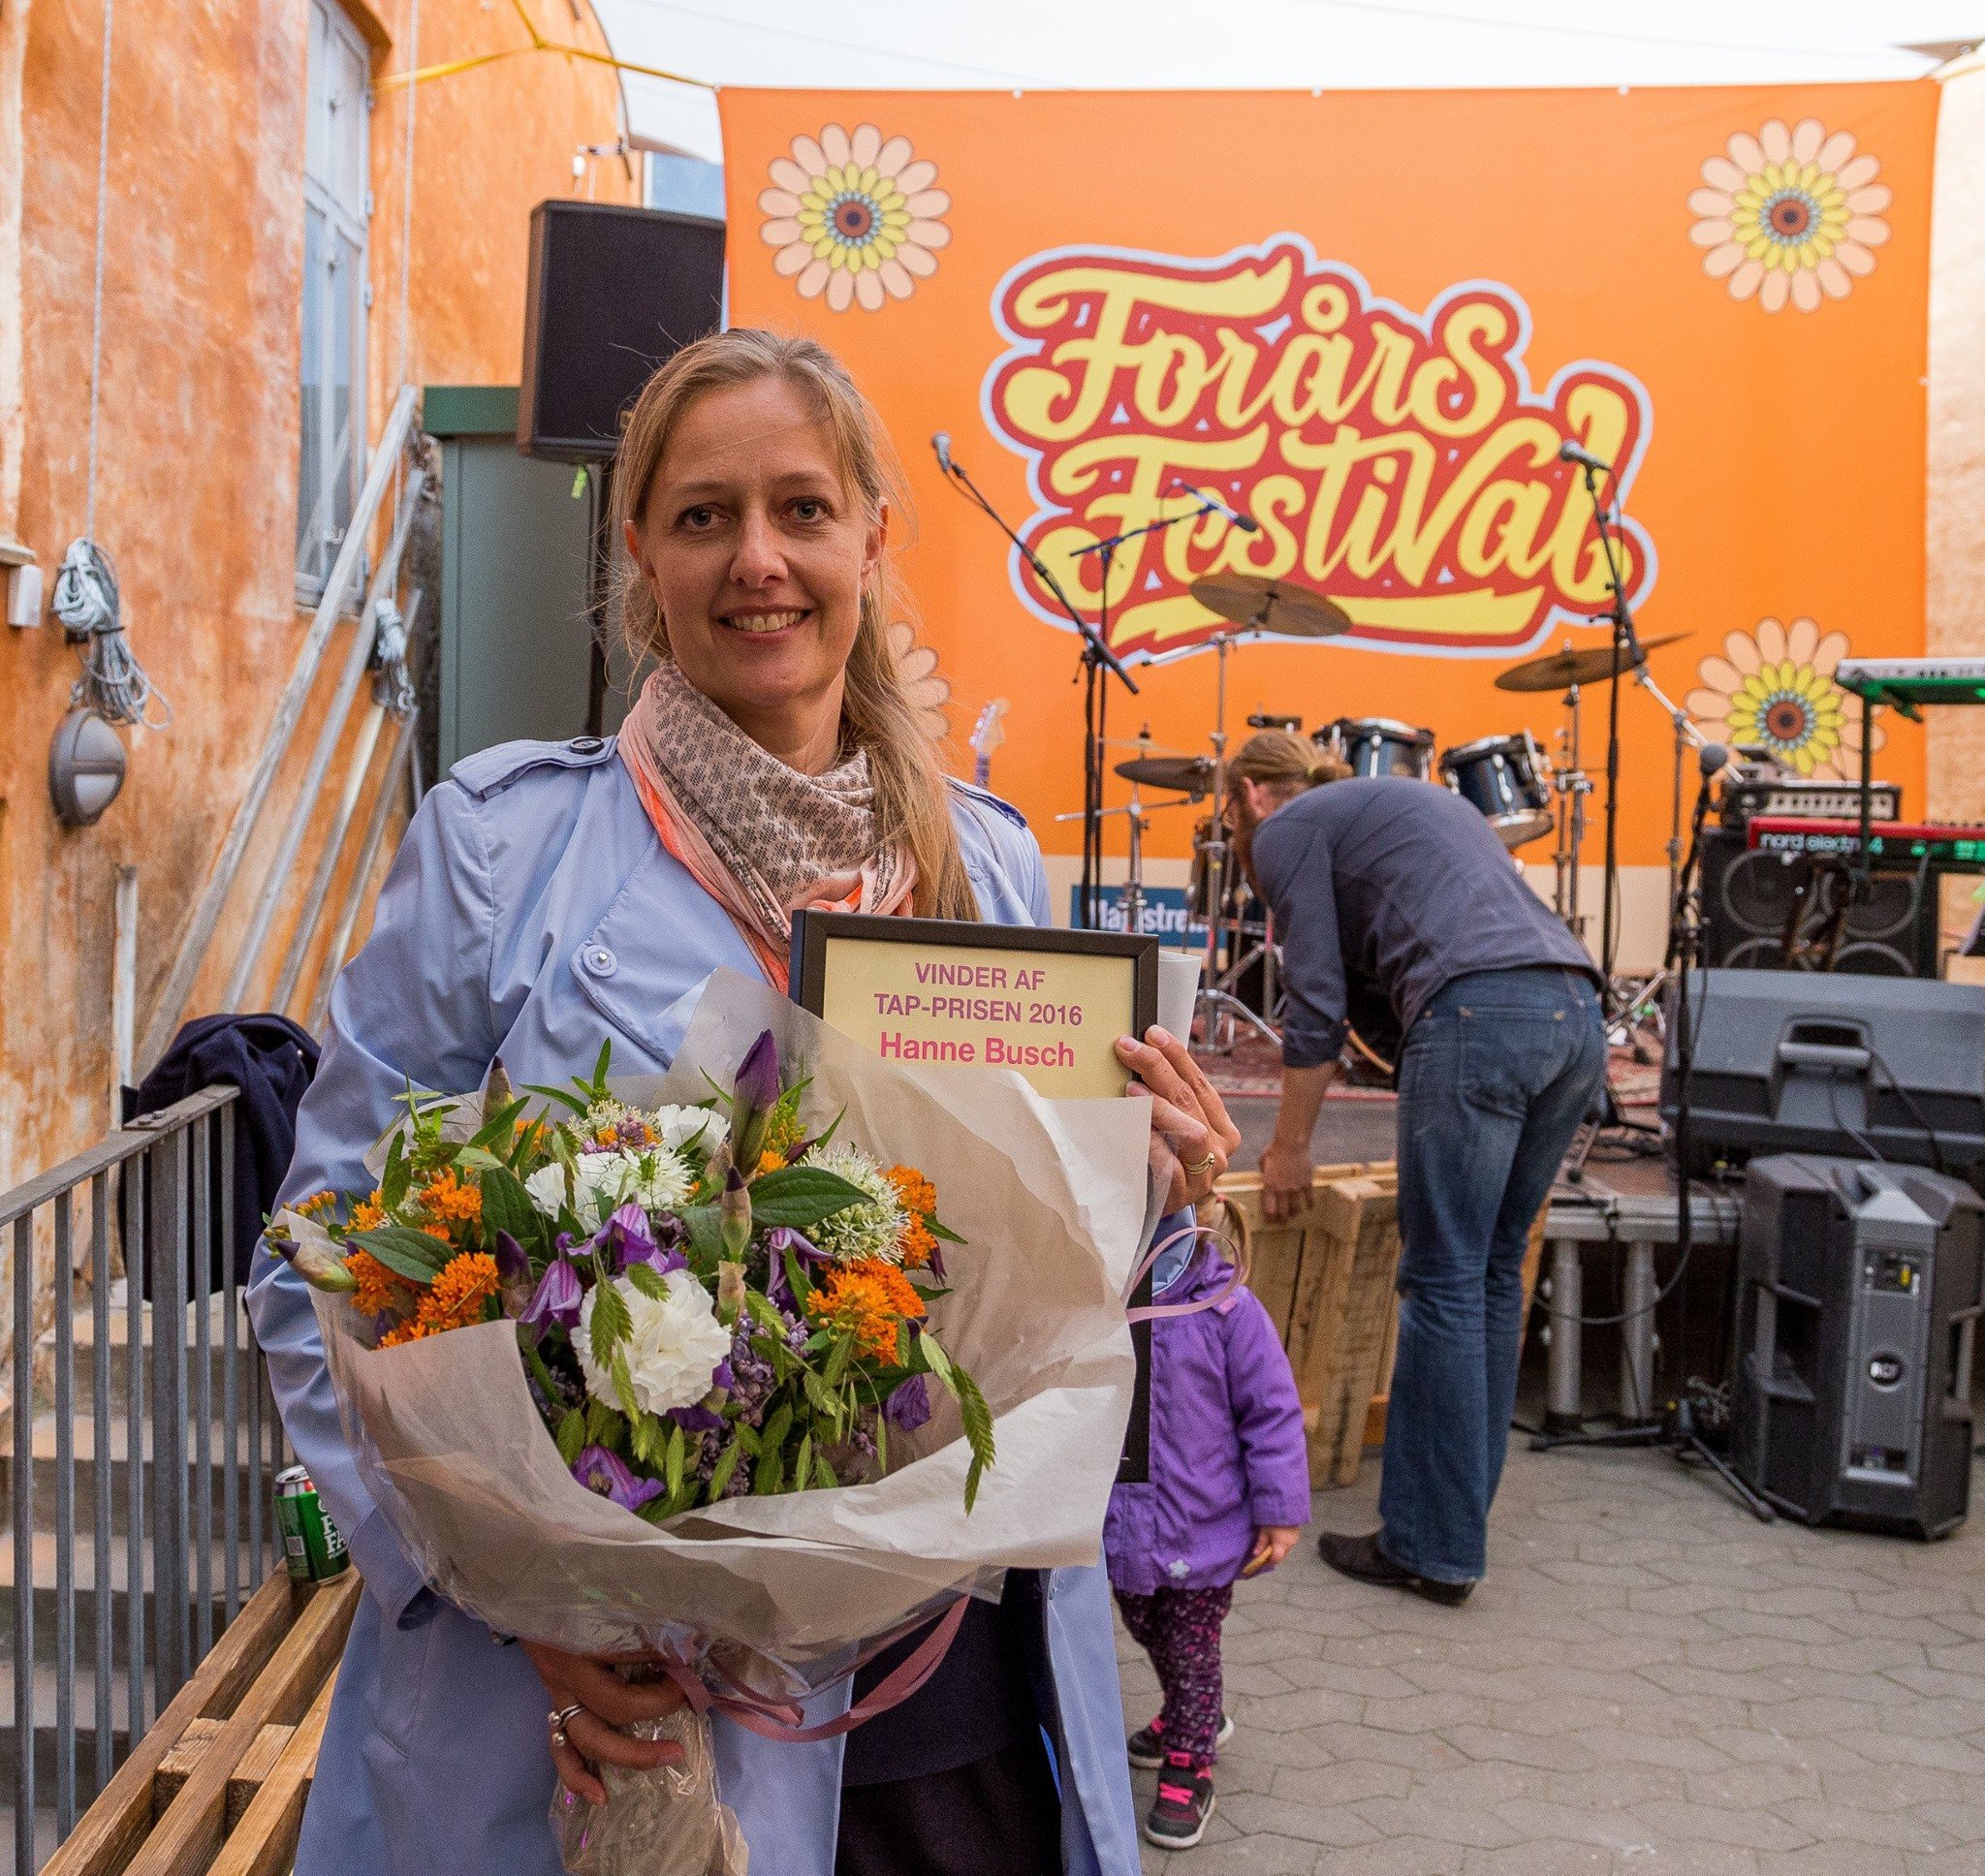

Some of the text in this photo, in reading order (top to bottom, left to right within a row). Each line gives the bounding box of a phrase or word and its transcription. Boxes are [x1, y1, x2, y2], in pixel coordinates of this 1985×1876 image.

[915, 962, 1046, 990] VINDER AF
[873, 993, 1083, 1026] TAP-PRISEN 2016
[879, 1031, 1075, 1067] Hanne Busch
